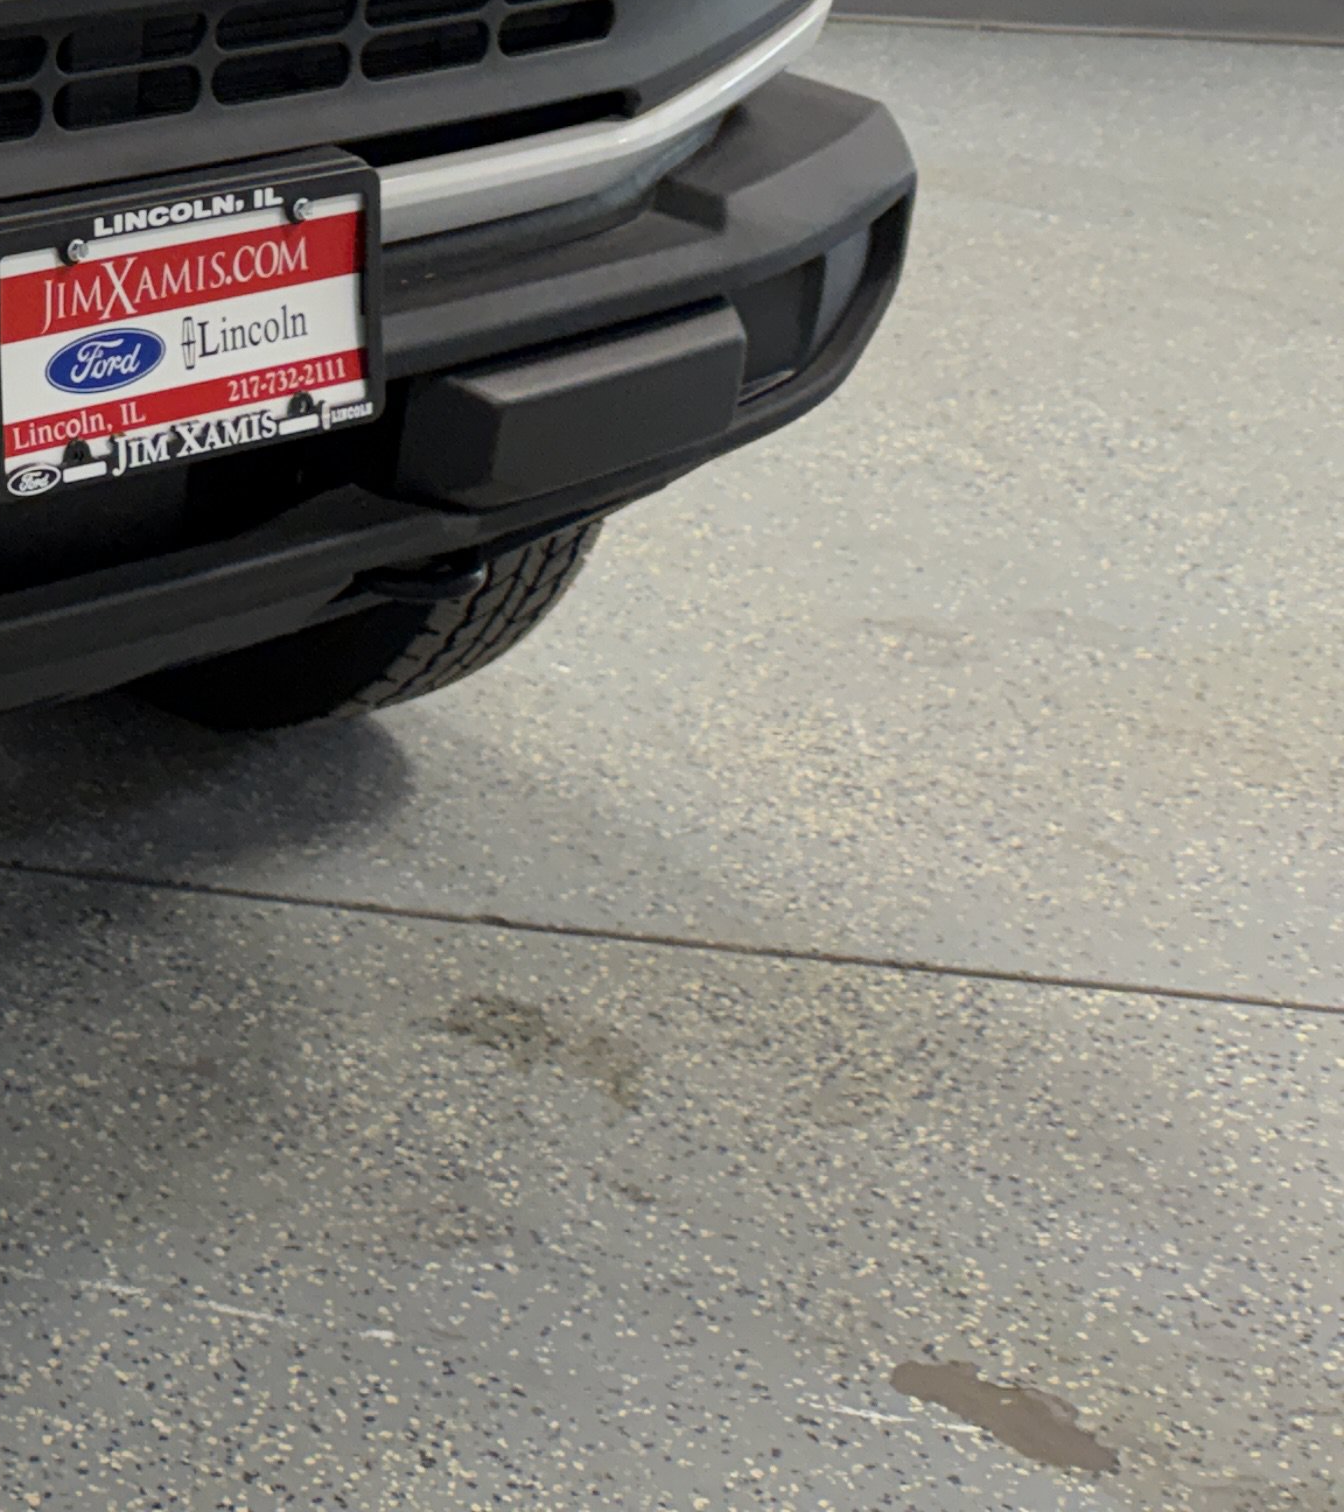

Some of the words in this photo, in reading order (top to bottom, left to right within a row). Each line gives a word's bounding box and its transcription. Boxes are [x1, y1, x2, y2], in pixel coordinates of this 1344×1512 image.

[93, 194, 245, 238] LINCOLN,
[253, 187, 285, 209] IL
[40, 236, 310, 335] JIMXAMIS.COM
[197, 304, 309, 358] Lincoln
[69, 338, 142, 384] Ford
[227, 356, 346, 403] 217-732-2111
[13, 410, 113, 451] Lincoln,
[119, 401, 147, 426] IL
[112, 434, 171, 477] JIM
[175, 410, 279, 457] XAMIS
[19, 471, 51, 492] Ford
